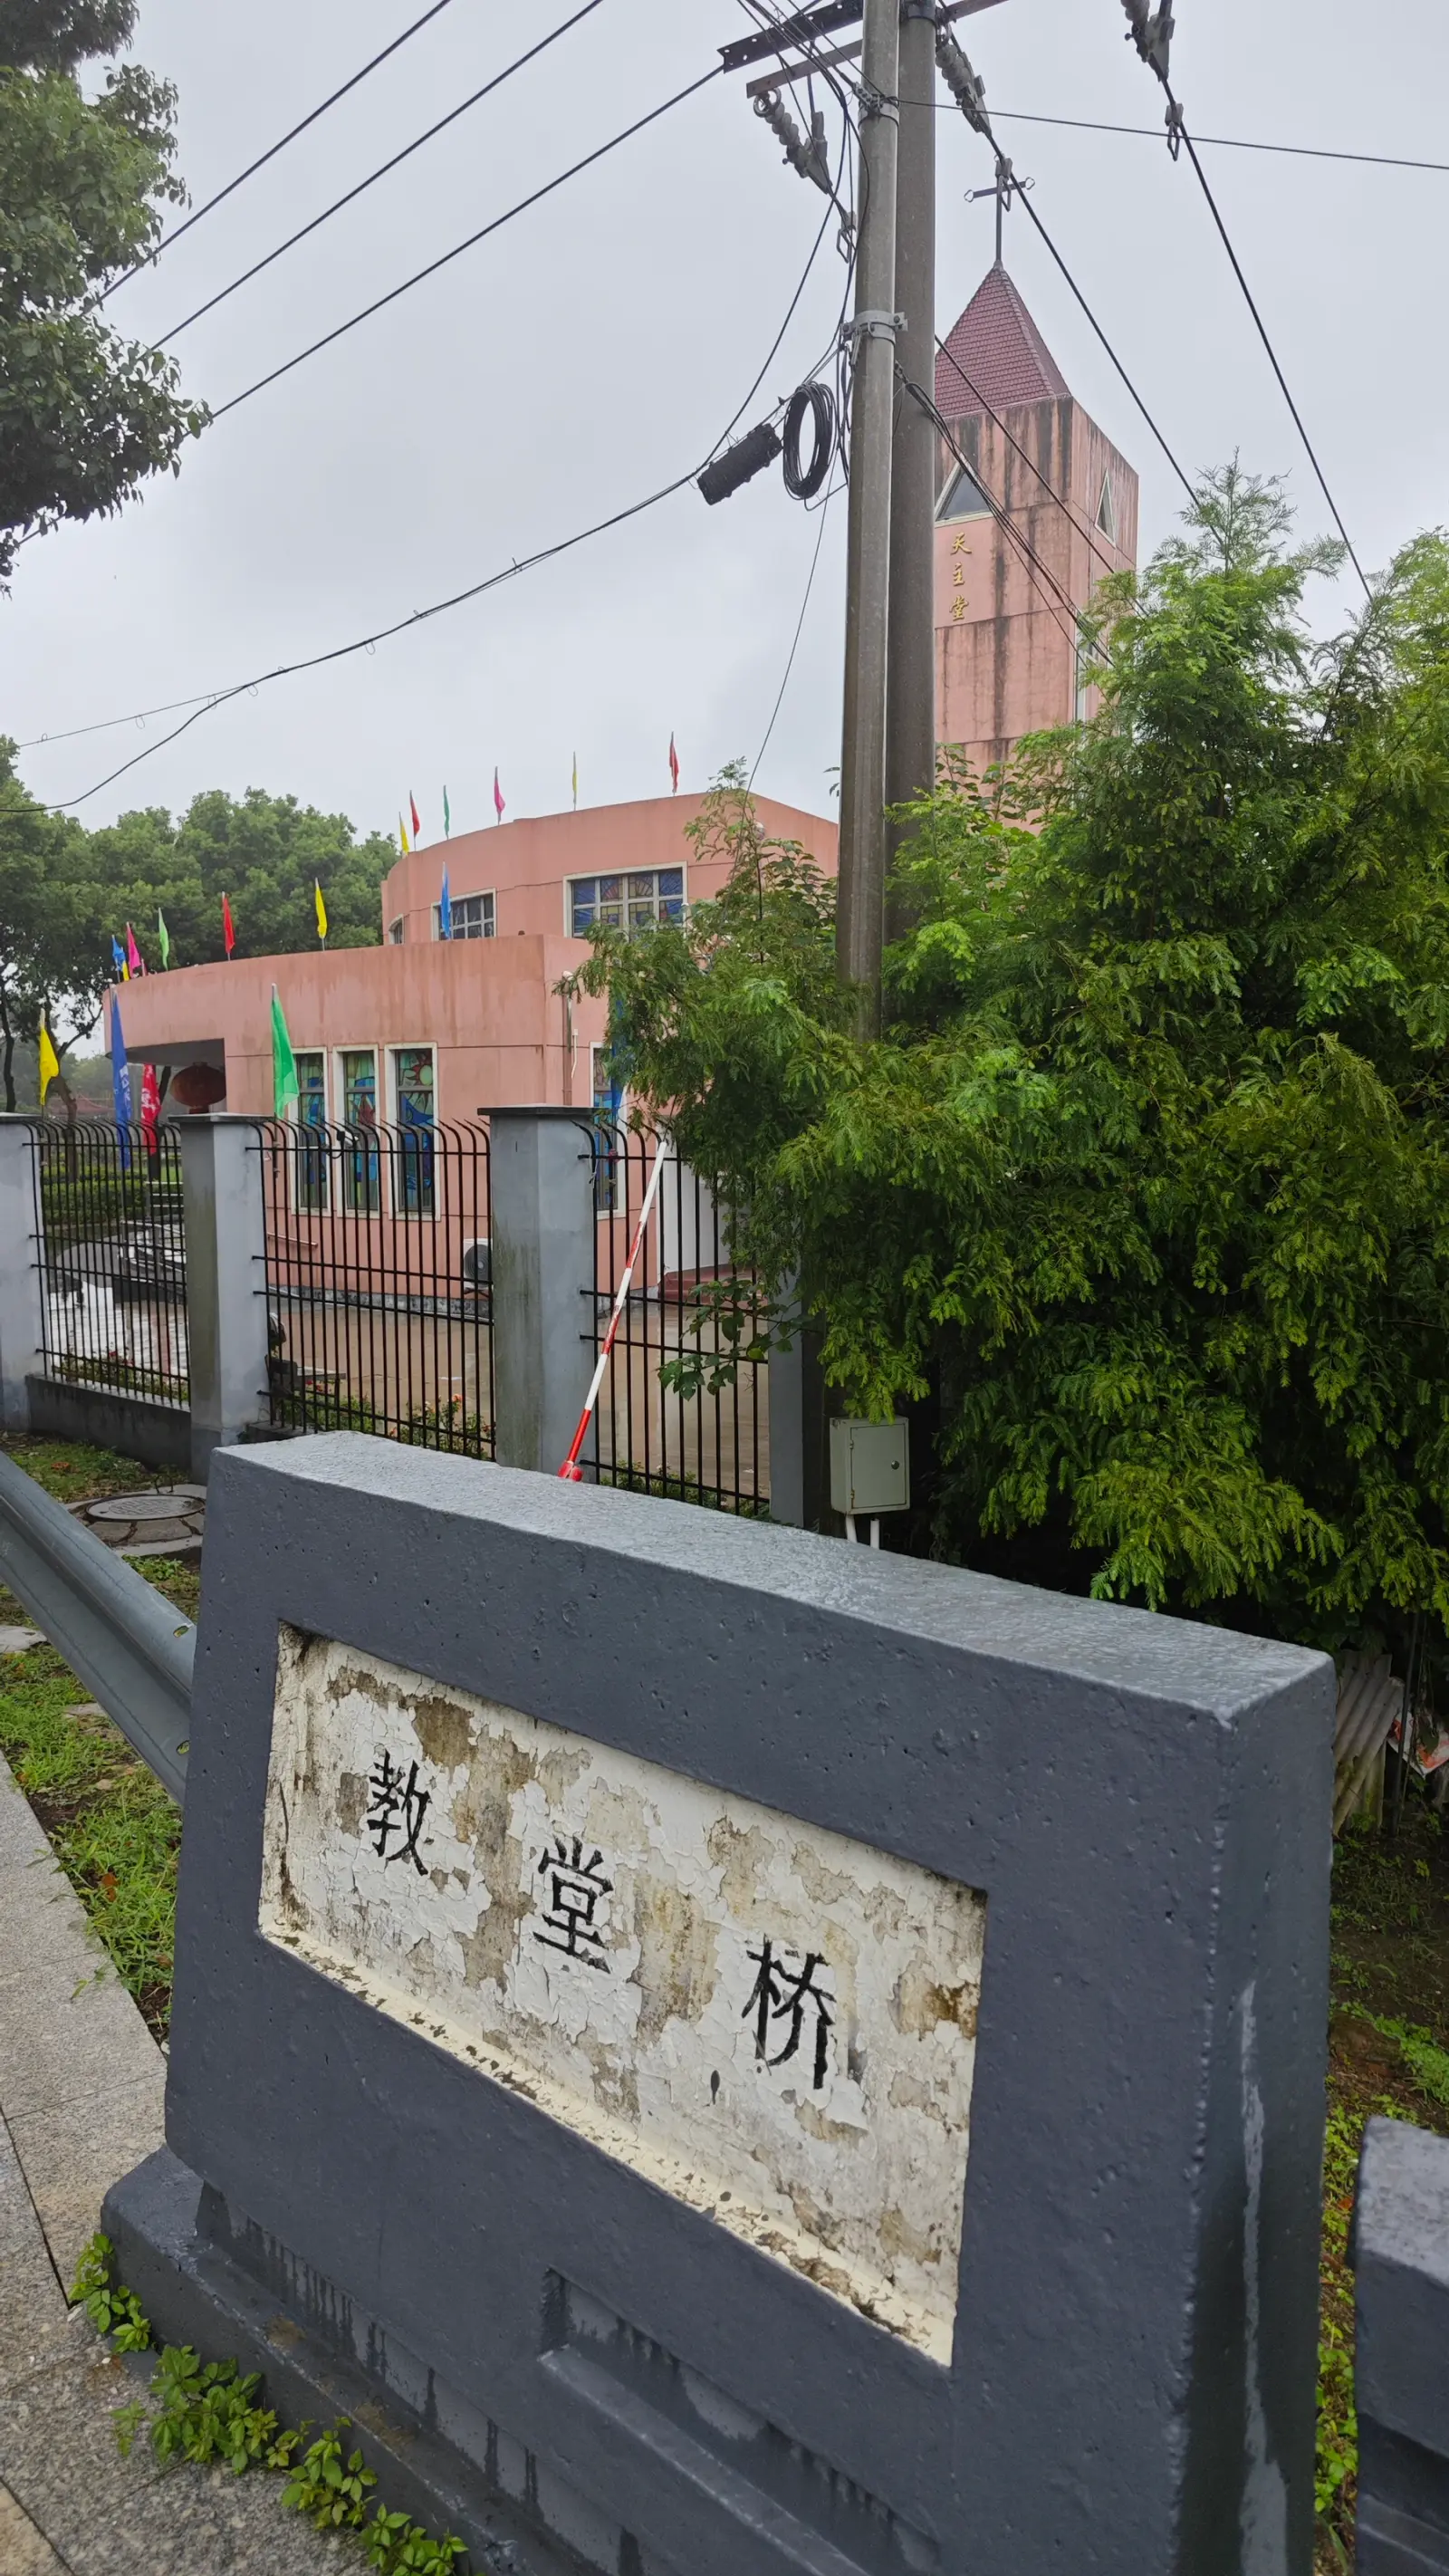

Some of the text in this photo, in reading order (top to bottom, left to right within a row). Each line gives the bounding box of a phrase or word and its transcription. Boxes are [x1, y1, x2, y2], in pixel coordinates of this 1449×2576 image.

[949, 532, 972, 621] 天主堂
[366, 1748, 837, 2090] 教堂桥
